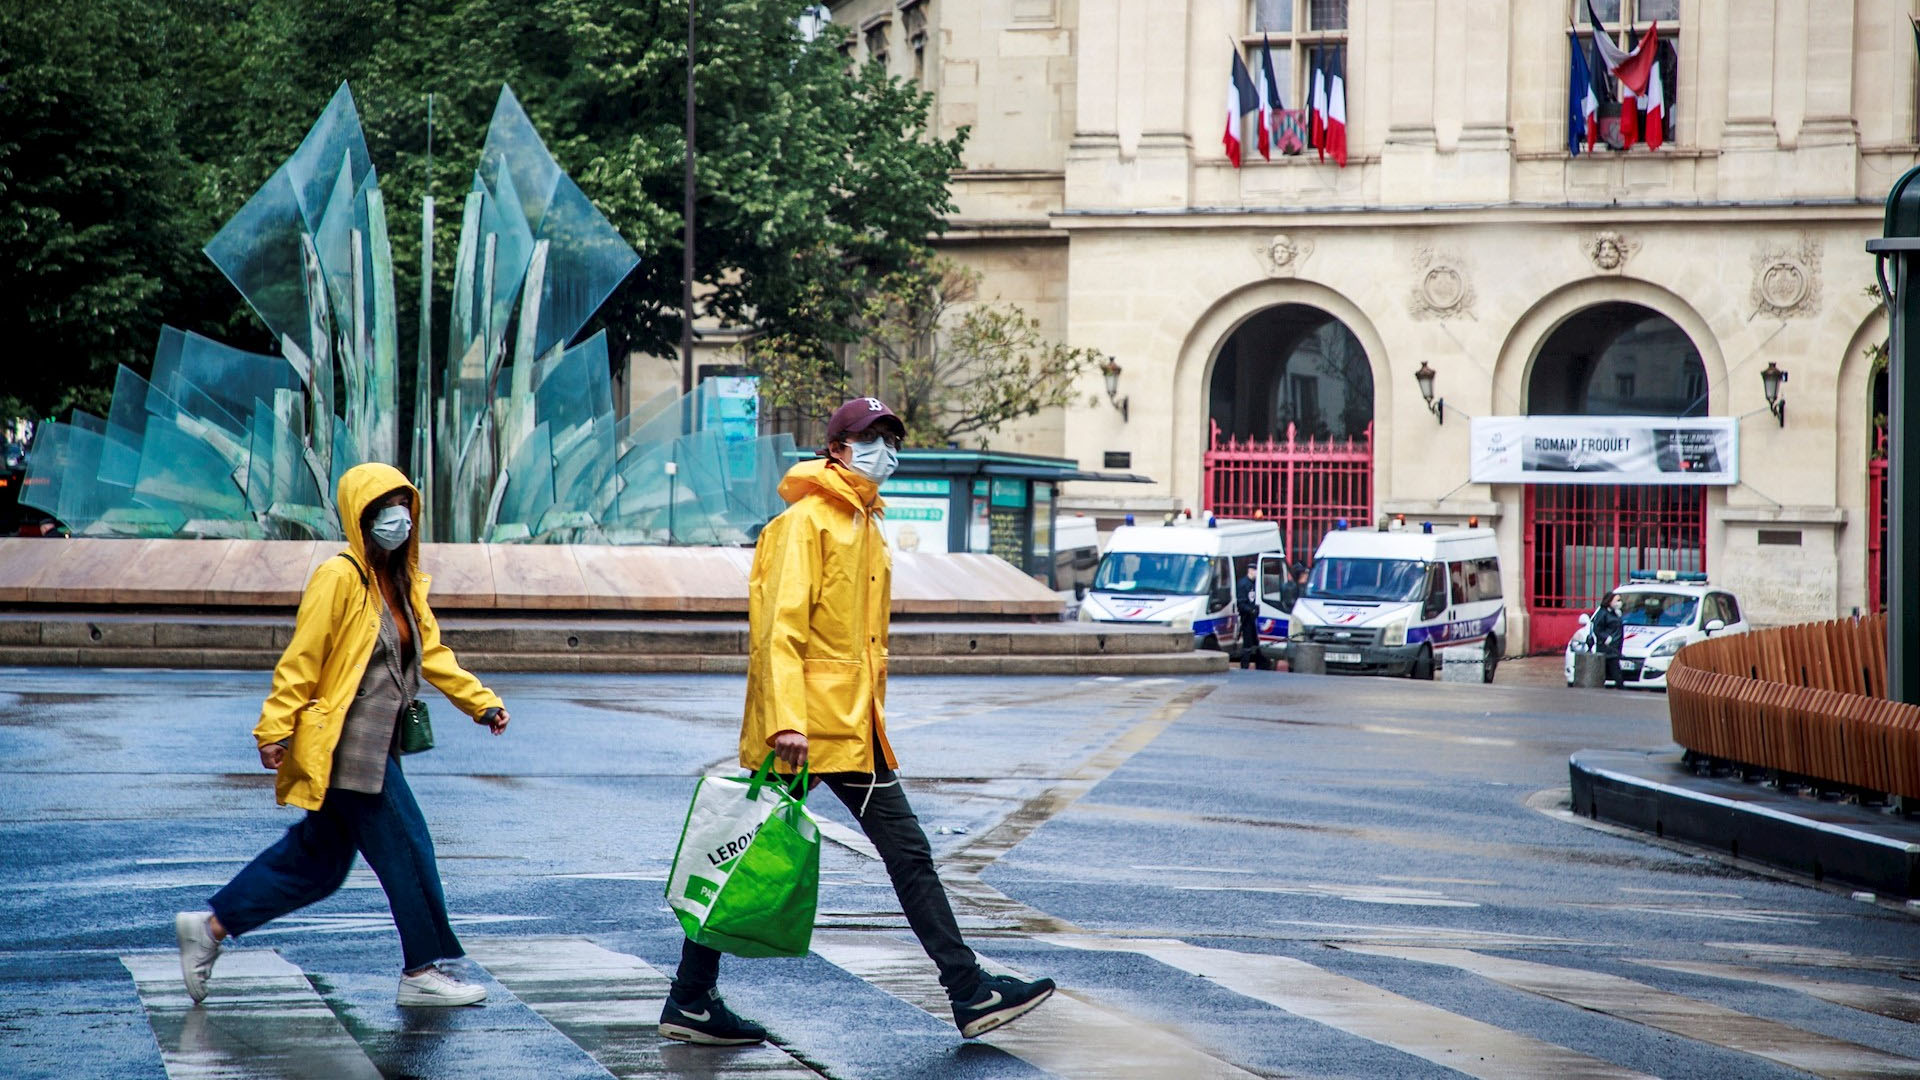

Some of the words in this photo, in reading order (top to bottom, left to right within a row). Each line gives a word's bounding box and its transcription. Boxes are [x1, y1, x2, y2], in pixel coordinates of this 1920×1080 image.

[1535, 437, 1578, 451] ROMAIN
[1581, 437, 1631, 453] FROQUET
[1453, 619, 1481, 639] POLICE
[707, 830, 754, 866] LEROY
